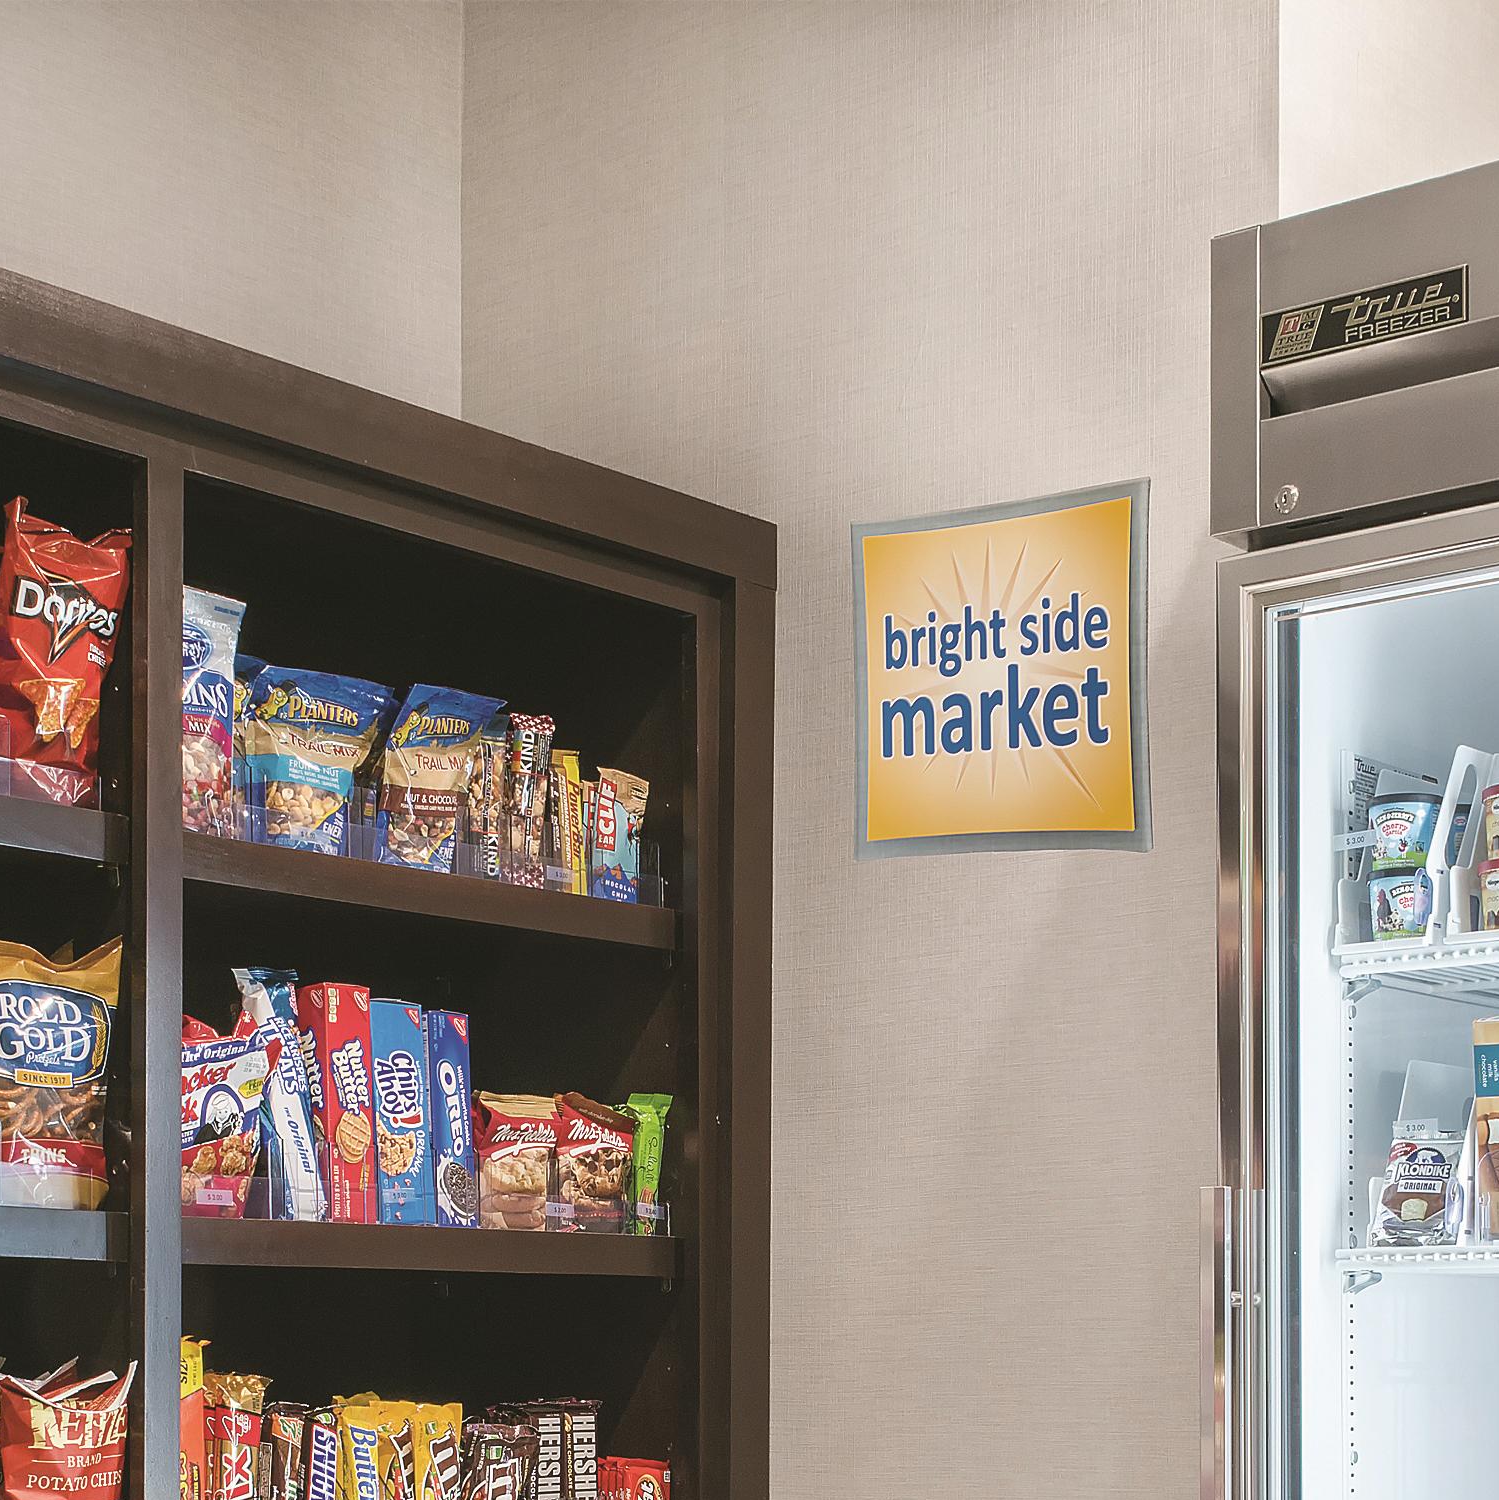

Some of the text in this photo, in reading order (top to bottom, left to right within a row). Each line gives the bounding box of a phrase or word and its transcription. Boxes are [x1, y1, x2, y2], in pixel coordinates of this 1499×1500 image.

[1331, 283, 1451, 327] true
[1345, 306, 1450, 343] FREEZER
[885, 593, 1109, 677] bright side
[289, 696, 359, 727] PLANTERS
[882, 664, 1109, 758] market
[417, 716, 470, 736] PLANTERS
[289, 733, 360, 758] TRAIL MIX
[520, 731, 535, 773] KIND
[415, 754, 448, 771] TRAIL
[487, 833, 498, 876] KIND
[437, 1060, 463, 1156] OREO
[517, 1124, 556, 1143] Fields
[1397, 1163, 1451, 1178] KLONDIKE
[1404, 1182, 1436, 1191] ORIGINAL
[67, 1454, 101, 1467] BRAND
[26, 1470, 122, 1491] POTATO CHIPS
